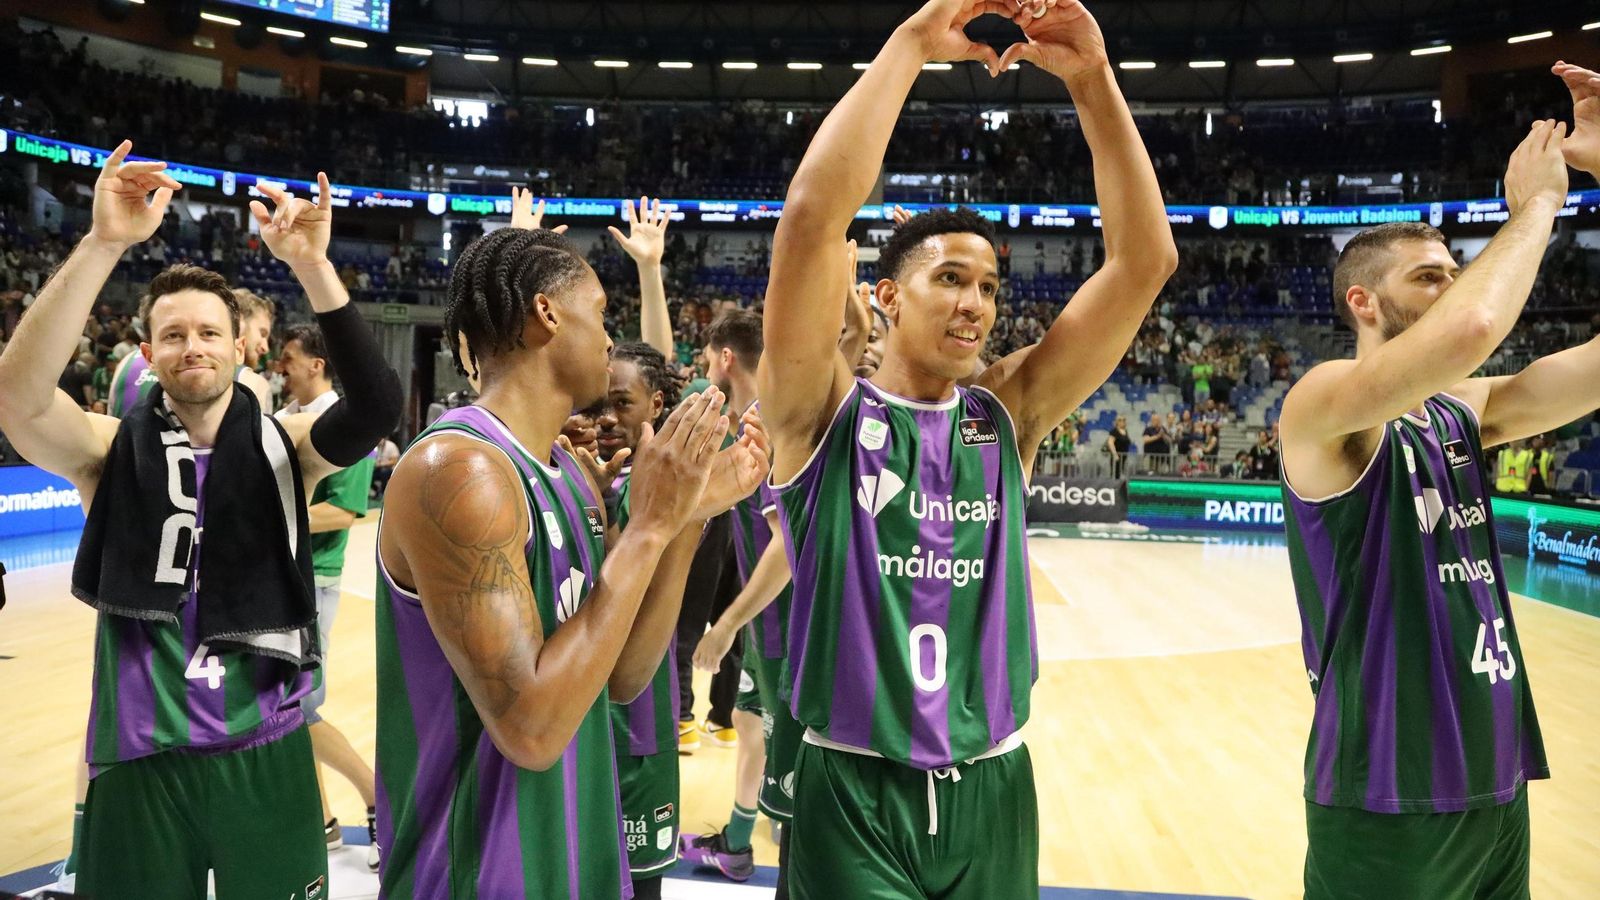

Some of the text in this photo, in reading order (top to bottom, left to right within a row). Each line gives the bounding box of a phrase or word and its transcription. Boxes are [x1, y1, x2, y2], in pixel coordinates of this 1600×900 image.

[15, 136, 68, 163] Unicaja
[70, 148, 92, 165] VS
[451, 198, 512, 215] Unicaja VS
[564, 202, 616, 216] Badalona
[1233, 208, 1421, 227] Unicaja VS Joventut Badalona
[965, 433, 996, 443] endesa
[1031, 481, 1115, 506] ndesa
[877, 545, 984, 587] málaga
[909, 623, 948, 692] 0
[1471, 617, 1517, 685] 45
[184, 643, 226, 690] 4
